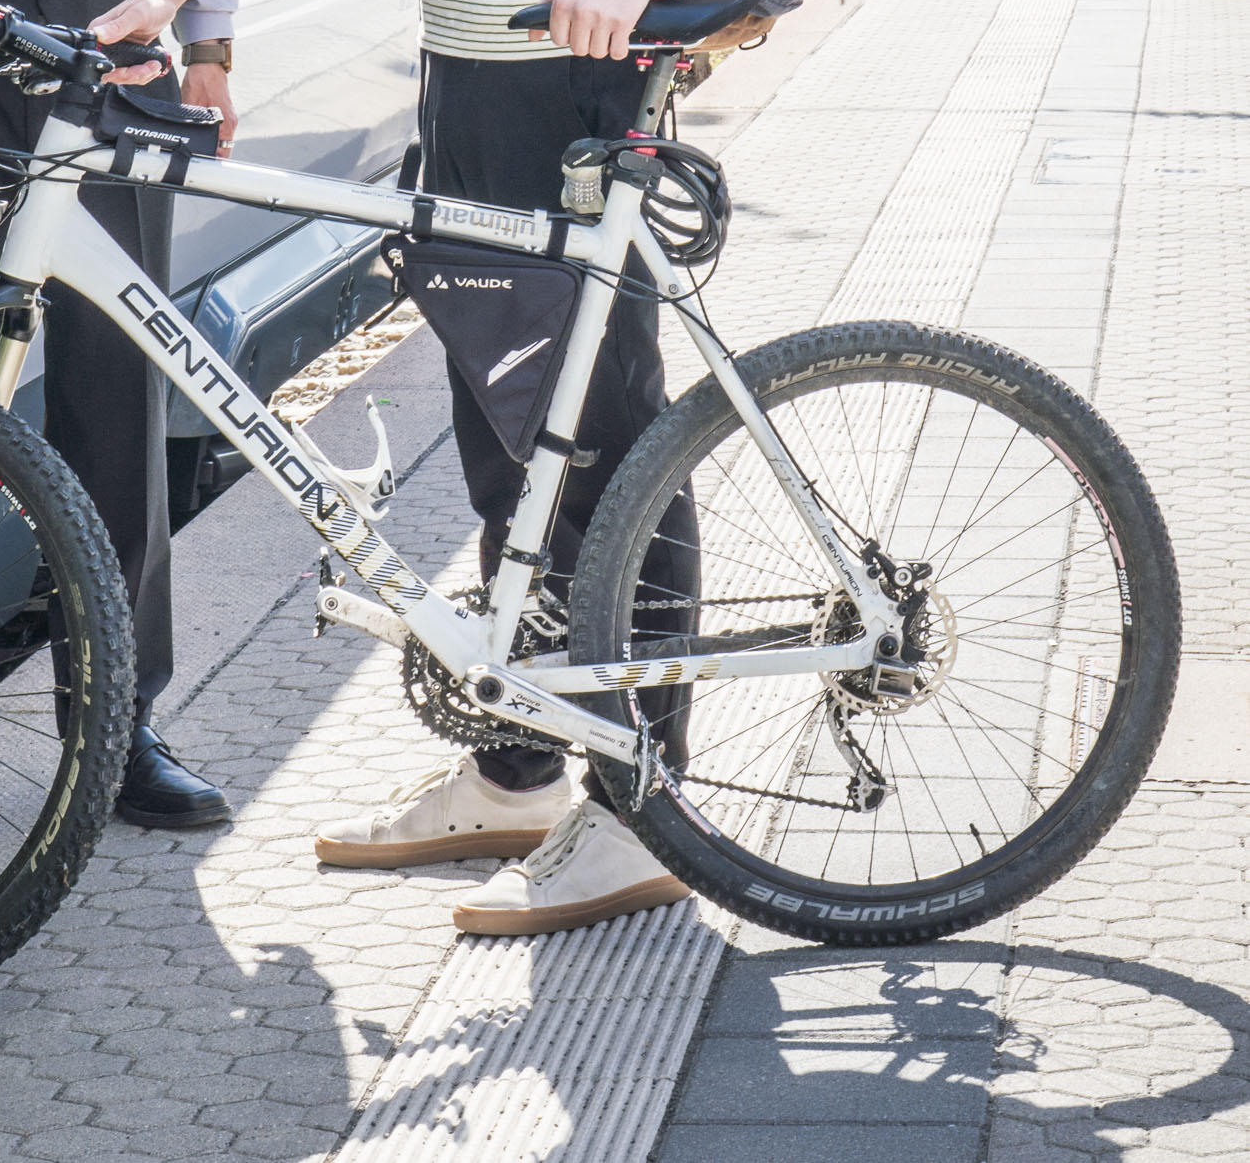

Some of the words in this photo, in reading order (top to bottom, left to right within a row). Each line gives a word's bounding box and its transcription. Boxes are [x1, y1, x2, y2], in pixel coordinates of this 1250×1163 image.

[16, 35, 59, 61] PROCRAFT
[124, 125, 191, 144] DYNAMICS
[432, 205, 537, 239] ultimate
[454, 277, 513, 290] VAUDE
[899, 352, 1022, 397] RACING
[117, 282, 340, 523] CENTURION
[0, 484, 23, 511] SWISS
[23, 514, 38, 531] DT
[822, 533, 863, 597] CENTURION
[1117, 569, 1132, 601] SWISS
[1123, 608, 1133, 627] DT
[504, 697, 543, 716] XT
[515, 692, 542, 707] Deore
[743, 881, 987, 923] SCHWALBE
